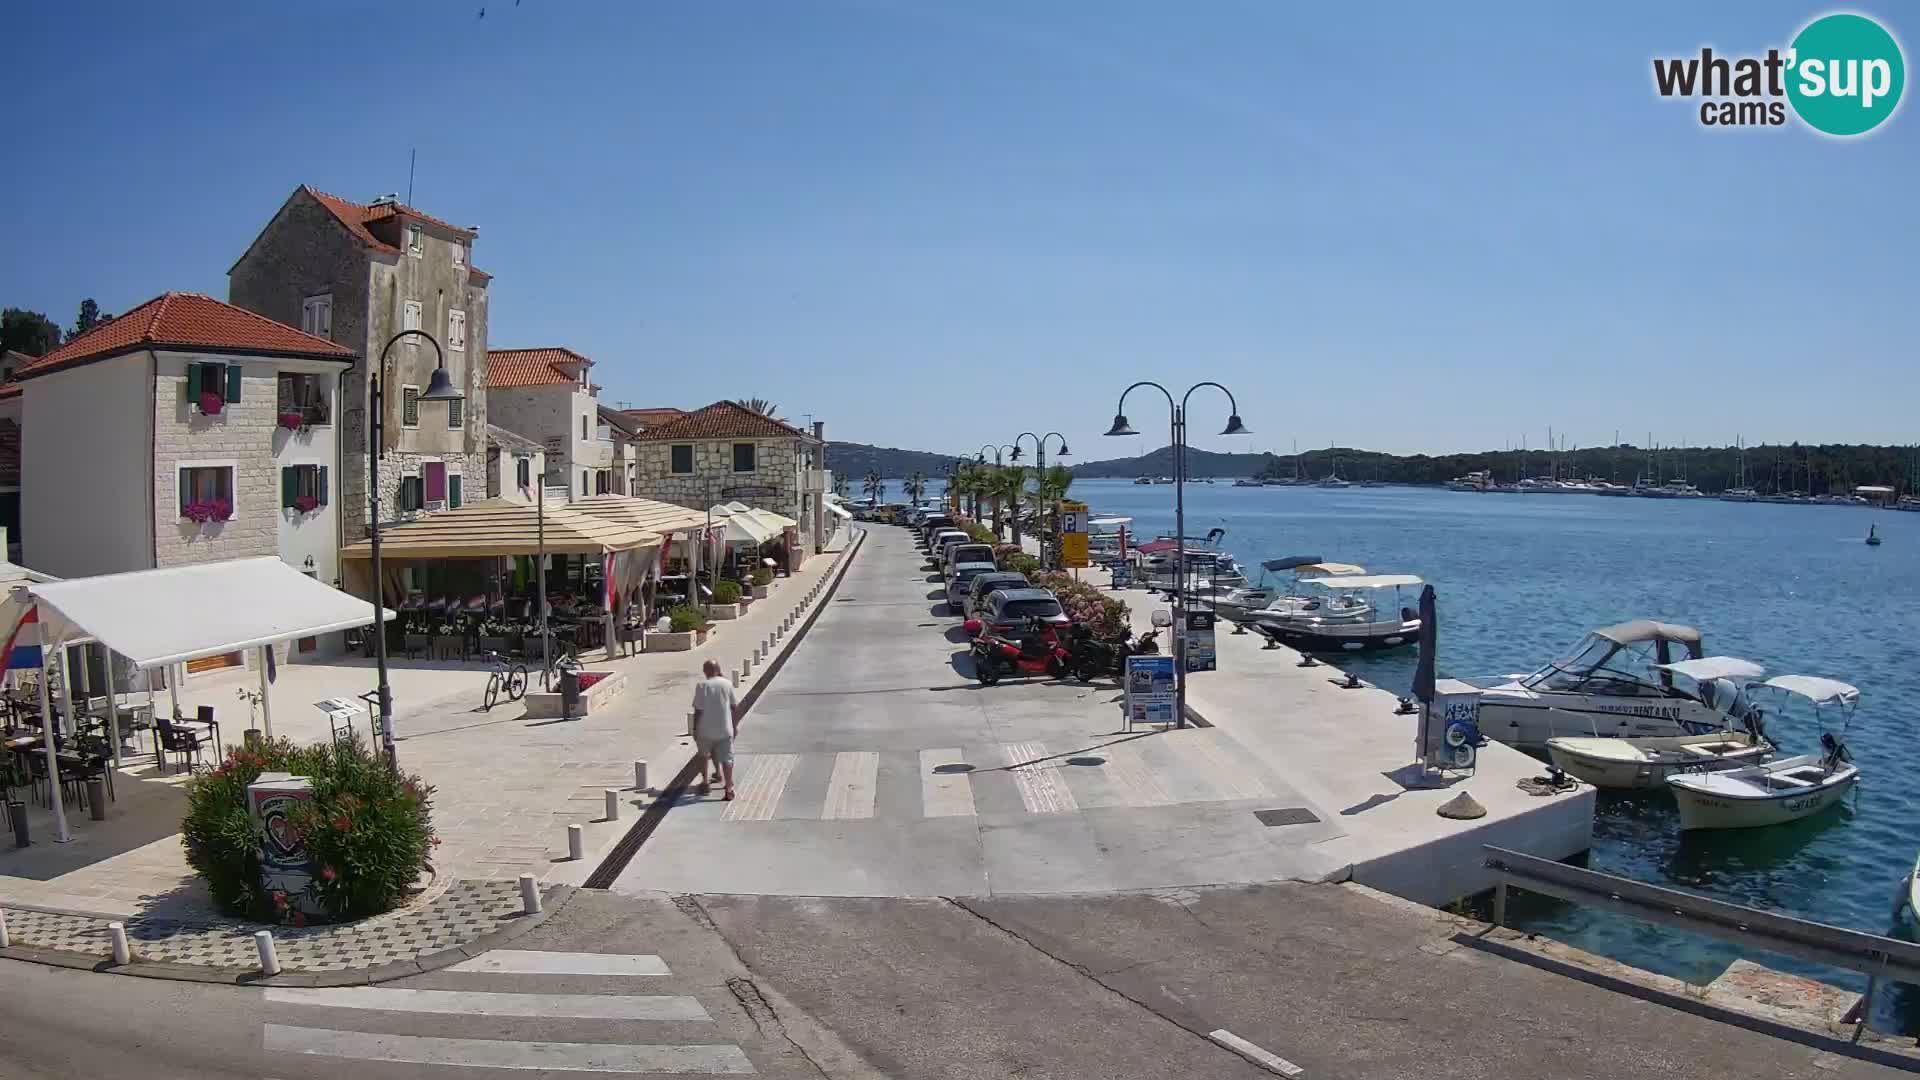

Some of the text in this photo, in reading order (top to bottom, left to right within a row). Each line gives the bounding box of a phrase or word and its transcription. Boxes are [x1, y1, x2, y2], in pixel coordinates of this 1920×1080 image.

[1064, 514, 1075, 530] P
[1447, 703, 1478, 711] RENT
[1633, 705, 1654, 716] RENT
